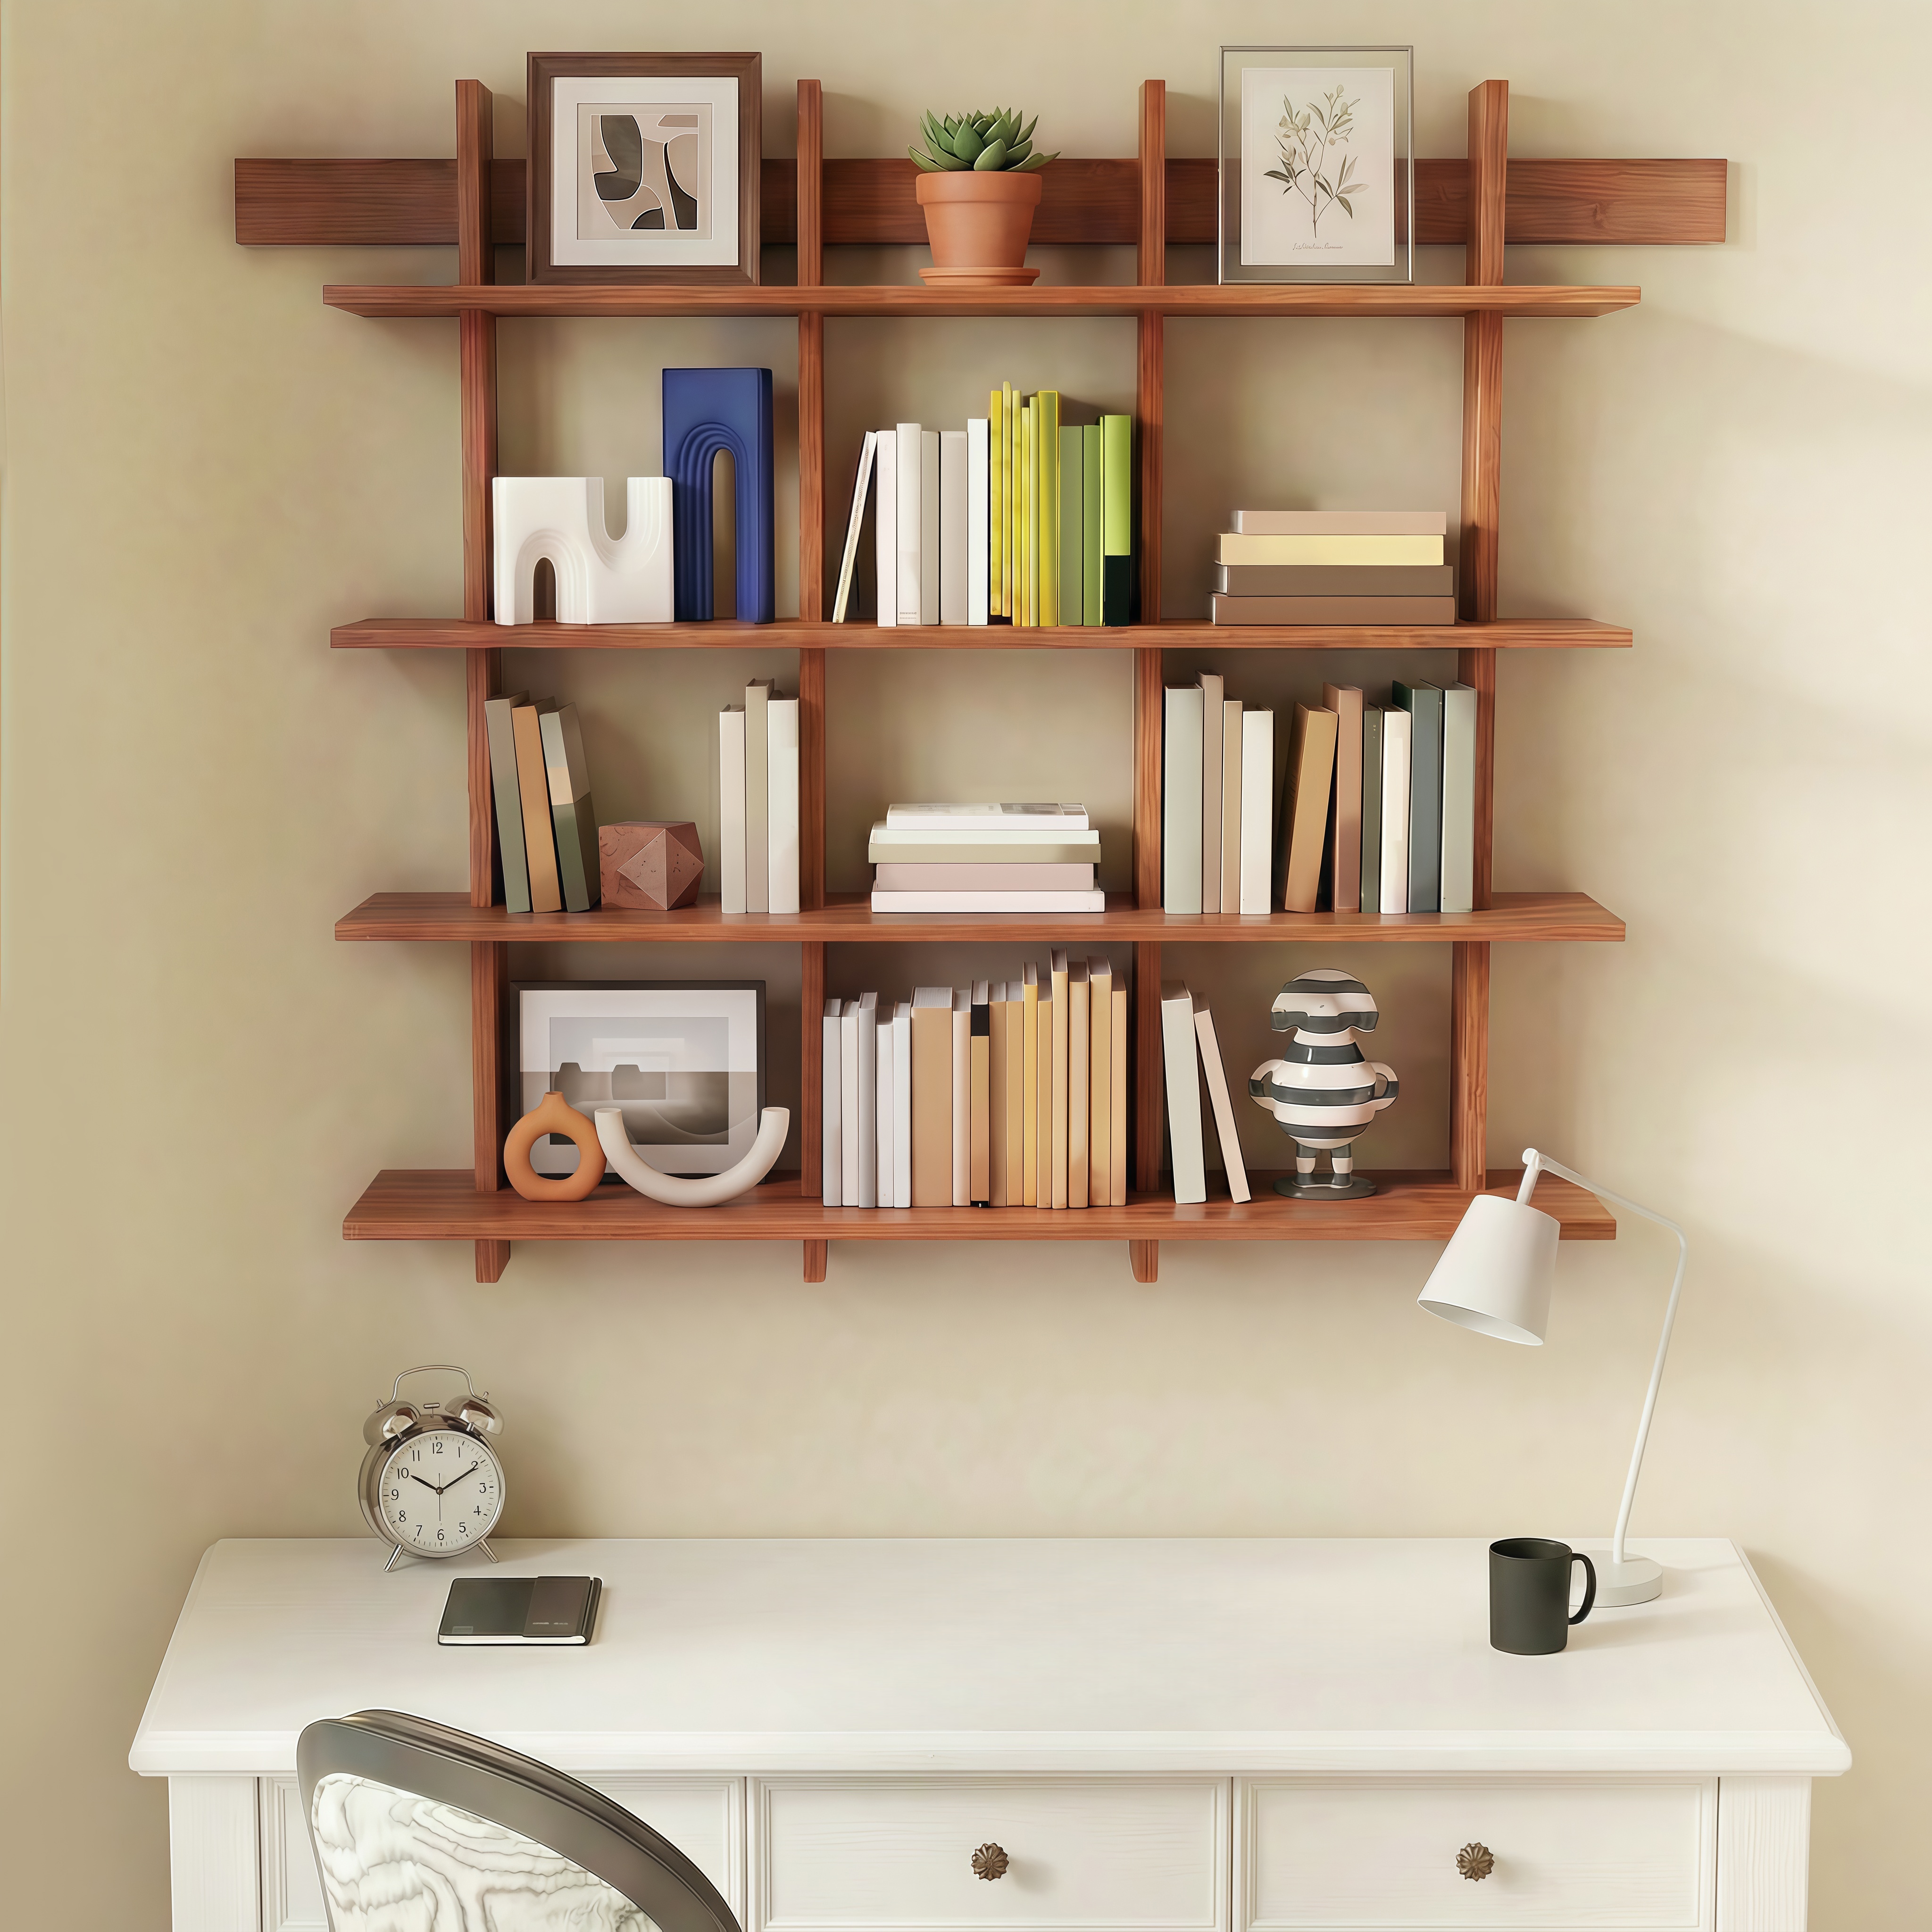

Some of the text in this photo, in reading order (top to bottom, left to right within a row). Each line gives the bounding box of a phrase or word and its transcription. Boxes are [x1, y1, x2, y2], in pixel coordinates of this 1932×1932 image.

[432, 1442, 443, 1454] 12
[458, 1446, 460, 1458] 1
[412, 1450, 420, 1462] 11
[471, 1460, 479, 1470] 2
[397, 1467, 409, 1480] 10
[479, 1482, 486, 1493] 3
[391, 1489, 399, 1500] 9
[399, 1510, 406, 1522] 8
[473, 1505, 482, 1516] 4
[416, 1525, 423, 1537] 7
[459, 1522, 466, 1533] 5
[437, 1529, 444, 1541] 6
